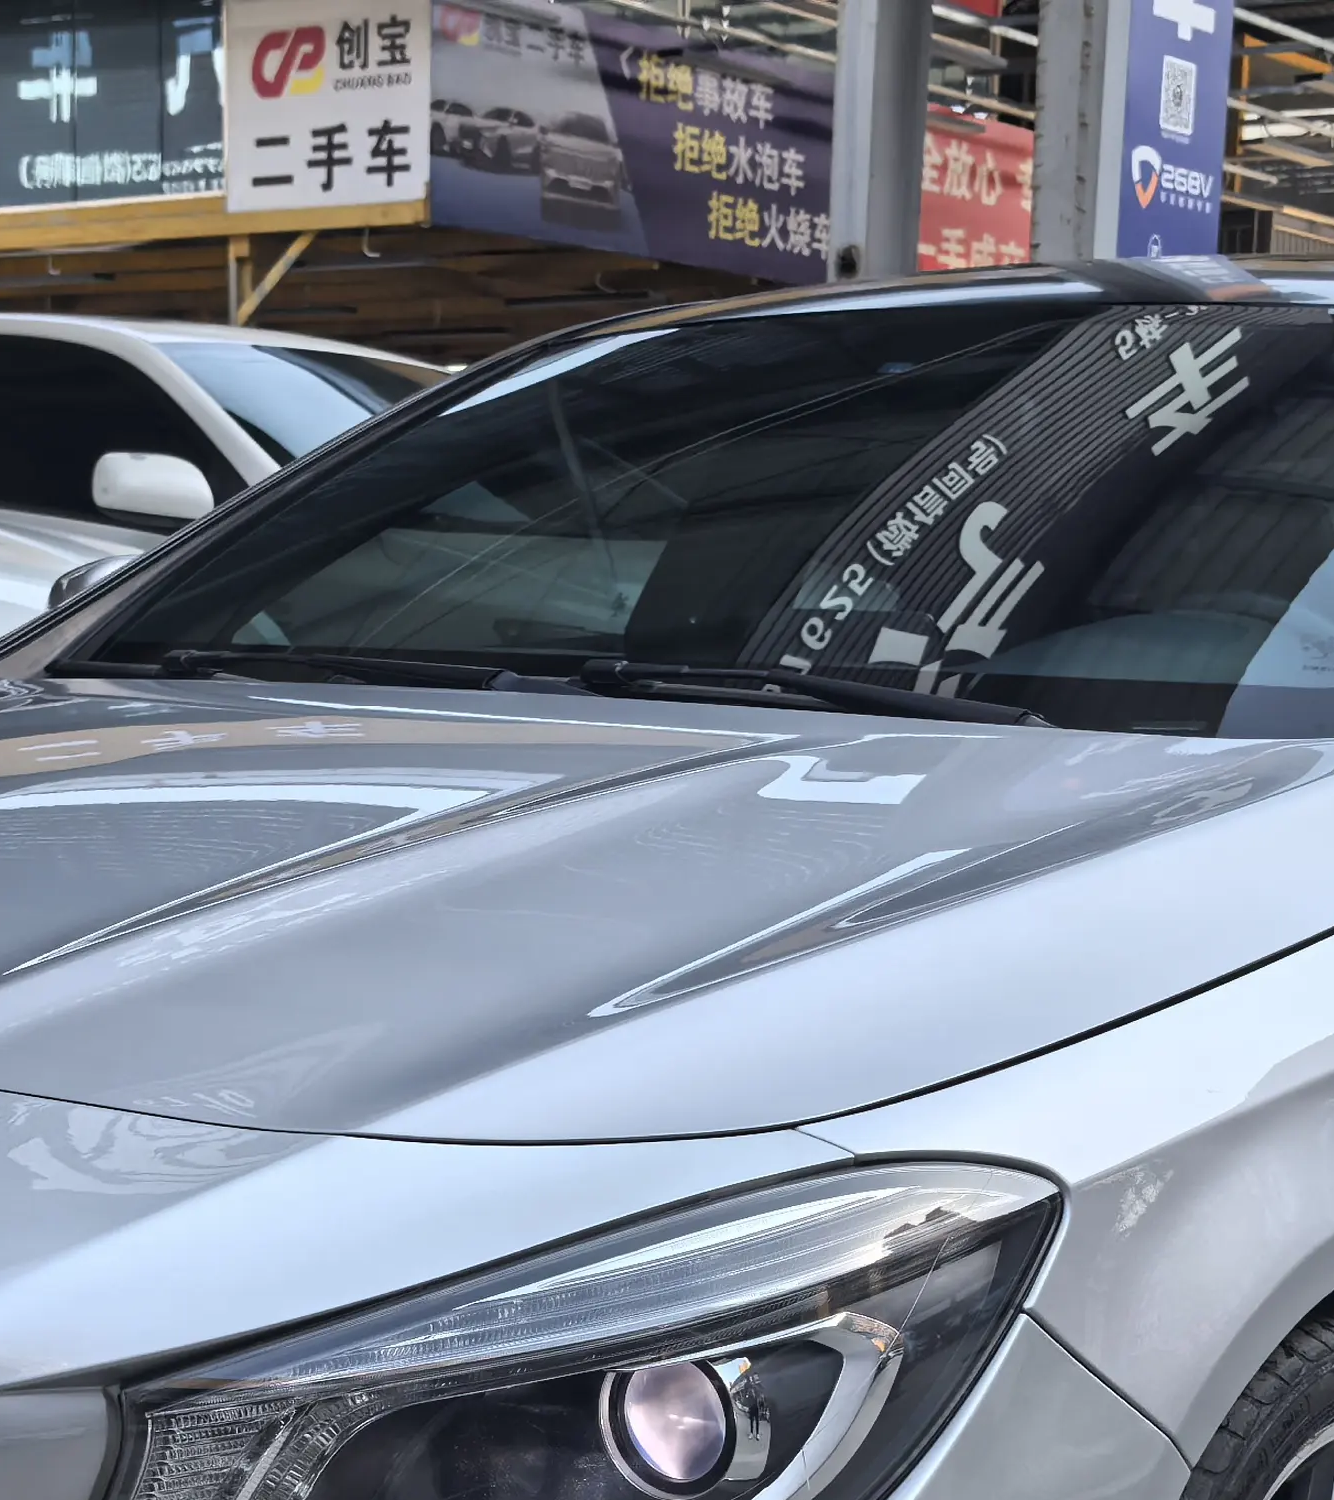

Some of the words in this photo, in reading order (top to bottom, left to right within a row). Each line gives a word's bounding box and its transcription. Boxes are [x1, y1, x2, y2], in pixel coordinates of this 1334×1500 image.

[334, 14, 412, 71] 创宝
[252, 118, 412, 192] 二手车
[673, 121, 806, 197] 拒绝水泡车
[707, 191, 831, 261] 拒绝火烧车
